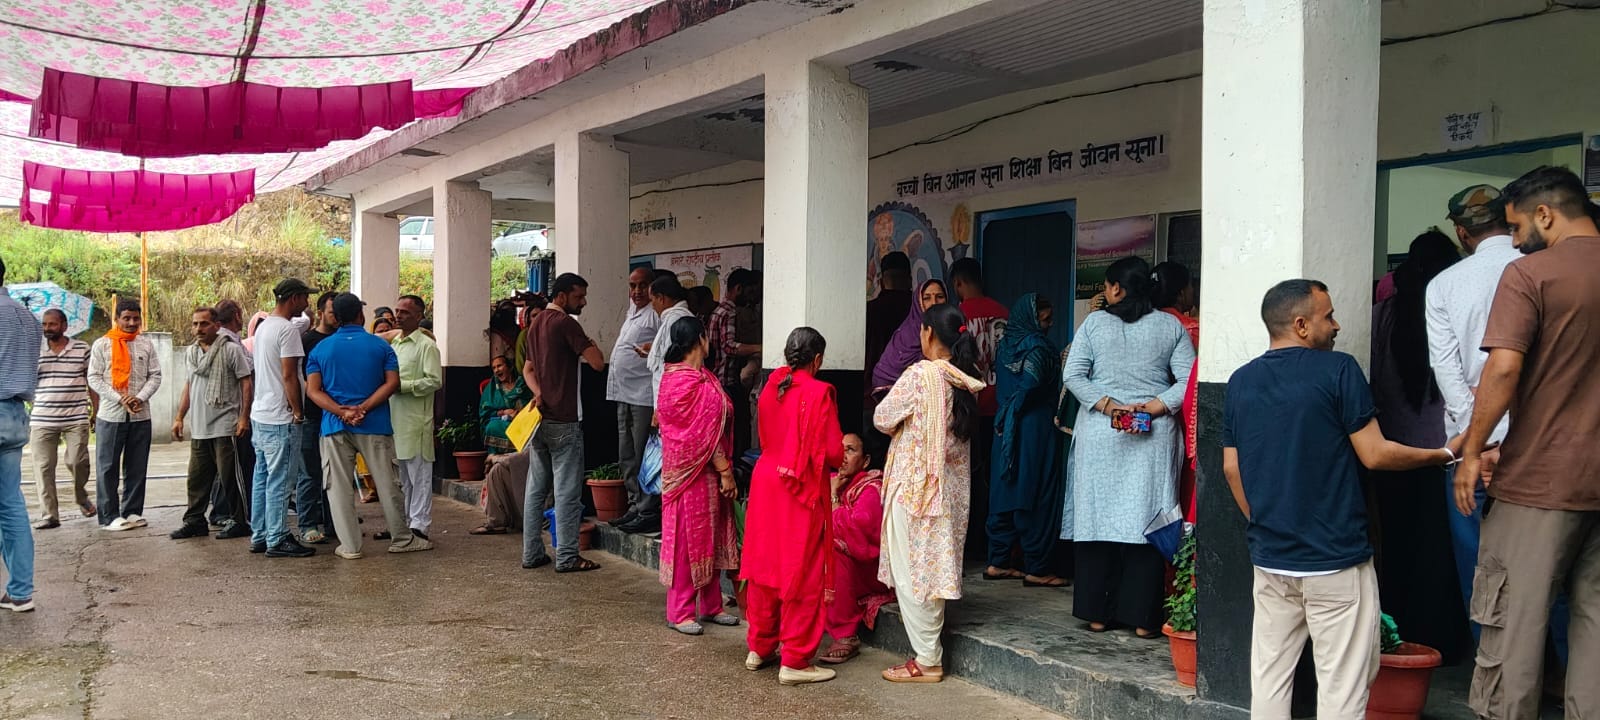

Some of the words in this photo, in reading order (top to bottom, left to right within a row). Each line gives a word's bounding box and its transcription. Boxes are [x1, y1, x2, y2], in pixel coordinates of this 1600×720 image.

[923, 173, 942, 193] बिन
[945, 169, 976, 191] आंगन
[981, 164, 1004, 189] सूना
[1009, 157, 1042, 179] शिक्षा
[1048, 149, 1073, 174] बिन
[1079, 142, 1120, 168] जीवन
